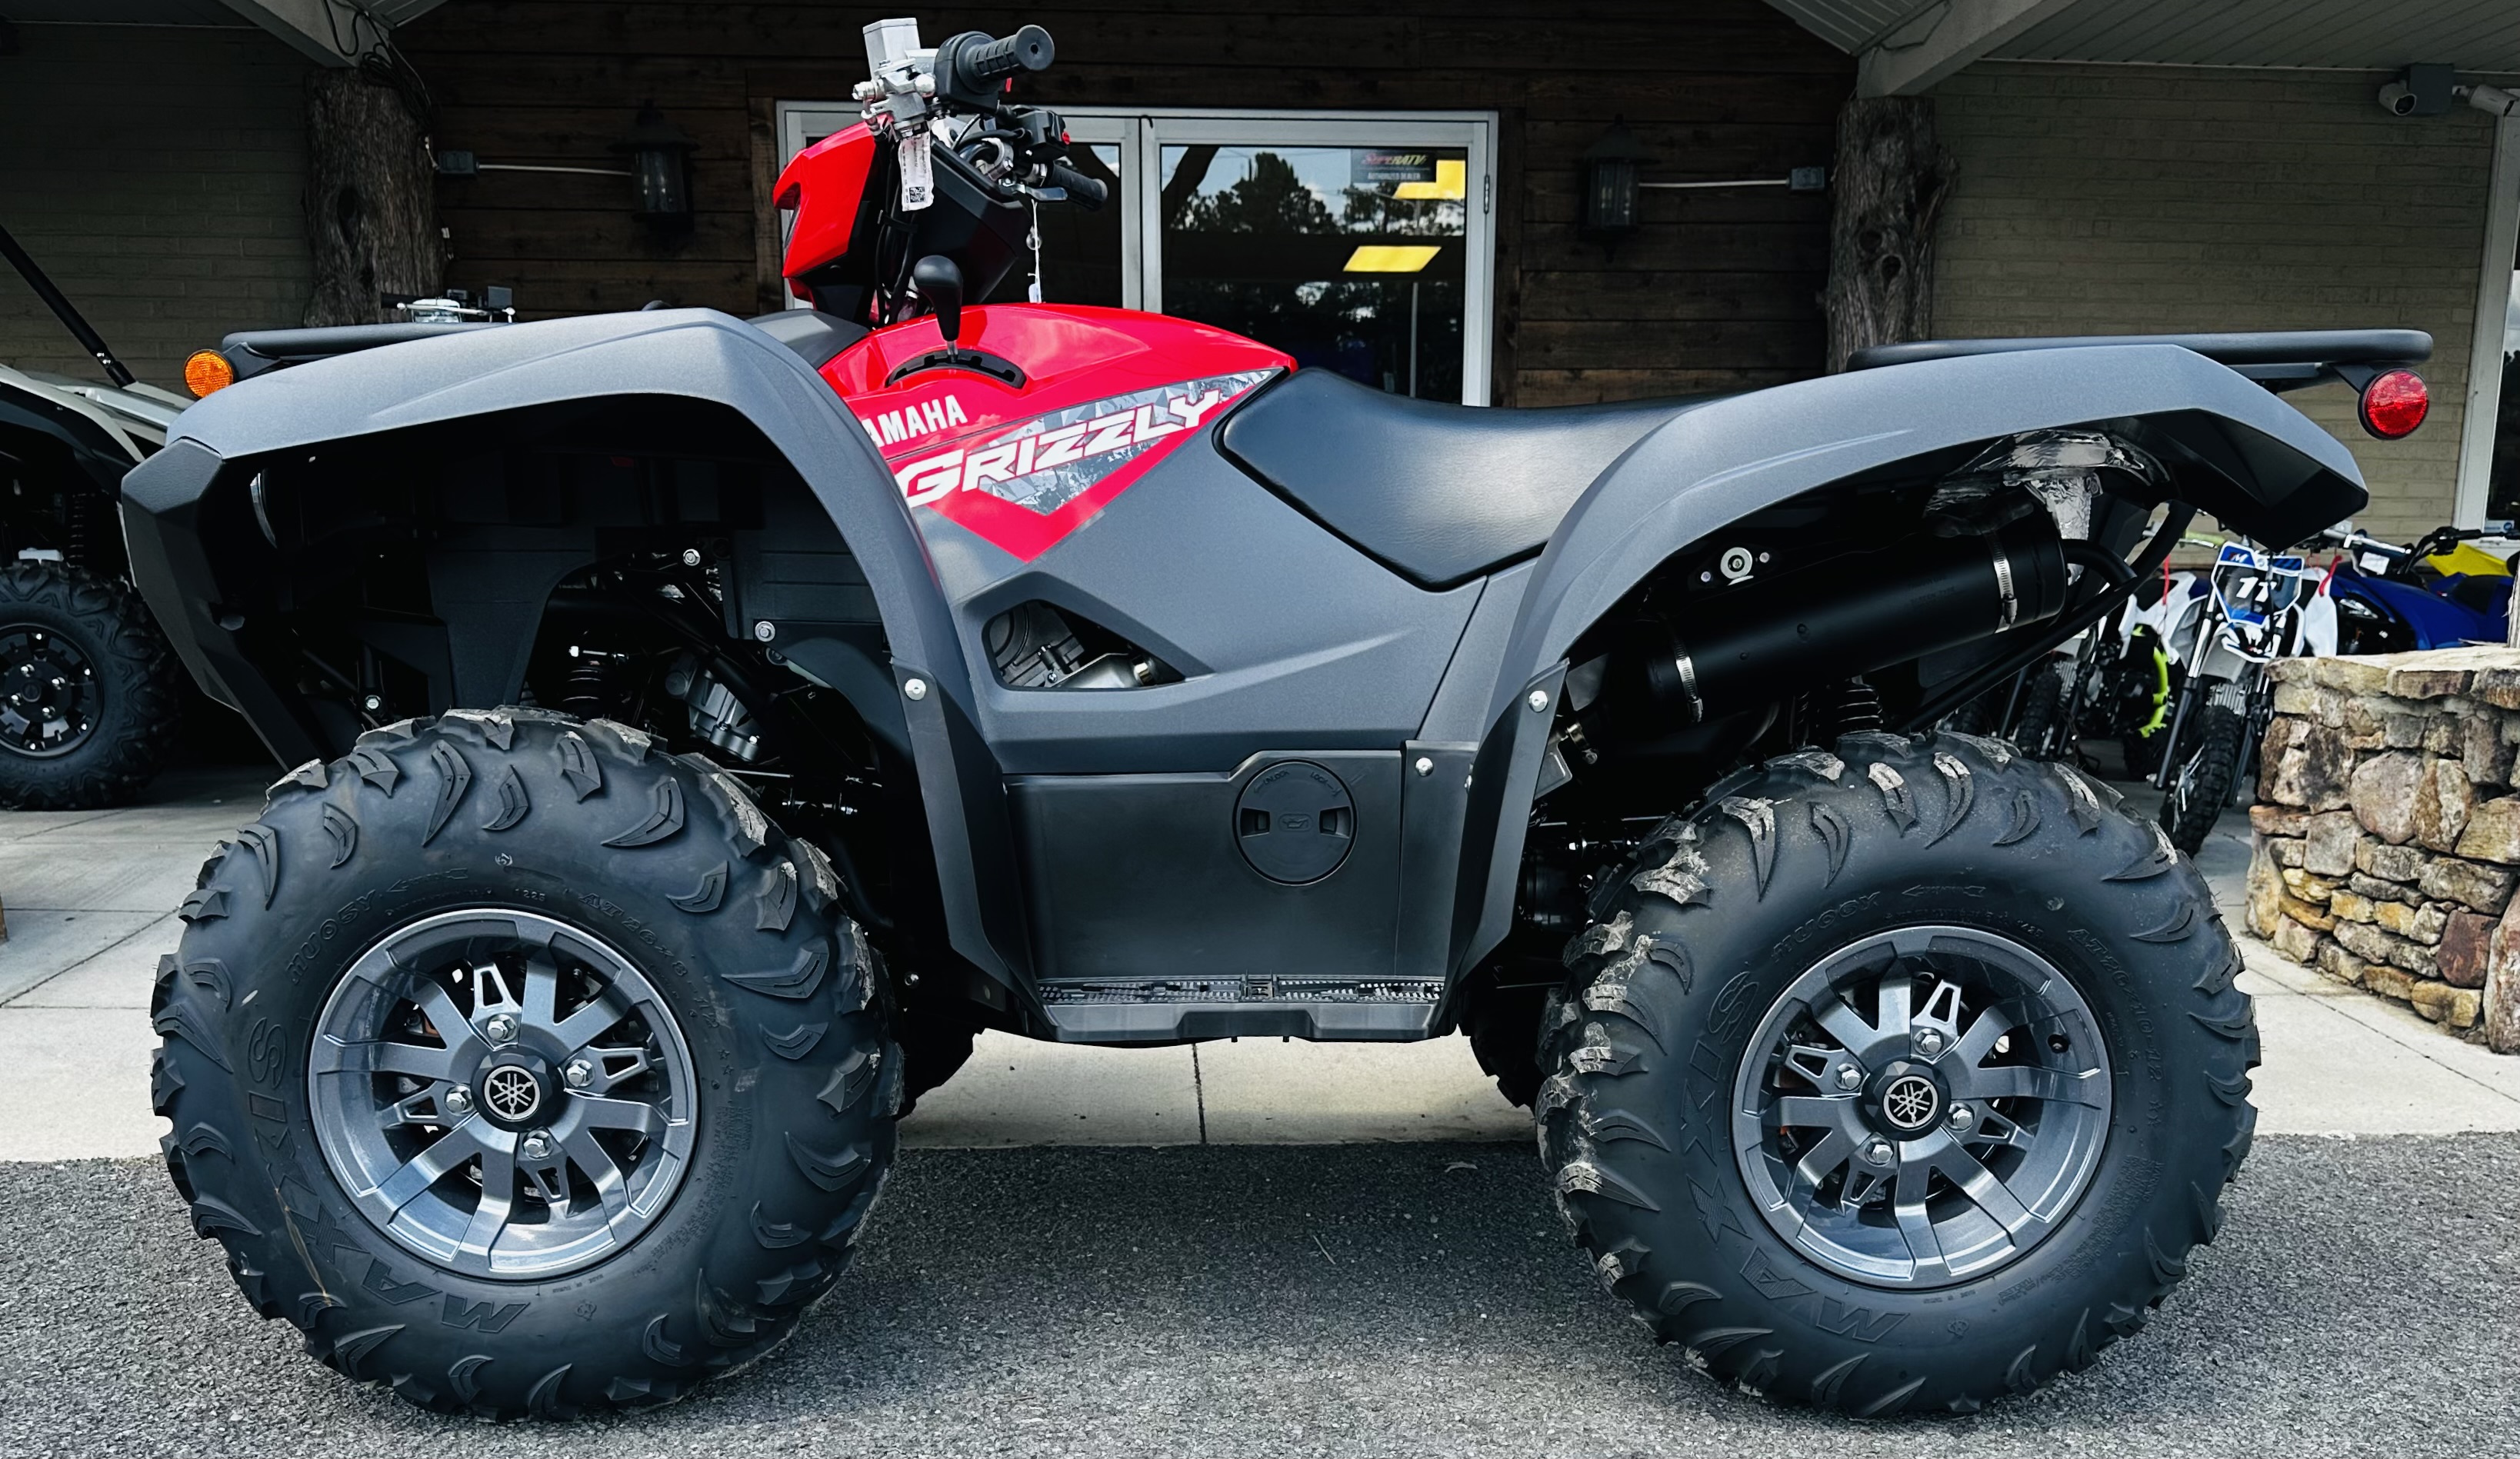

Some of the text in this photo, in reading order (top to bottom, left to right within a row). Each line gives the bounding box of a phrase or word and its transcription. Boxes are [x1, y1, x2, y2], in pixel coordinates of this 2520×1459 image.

[862, 395, 968, 448] AMAHA
[894, 389, 1222, 508] GRIZZLY
[1263, 770, 1290, 784] UNLOCK
[1310, 771, 1328, 784] LOCK
[246, 1017, 531, 1334] MAXXIS
[1680, 971, 1912, 1343] MAXXIS
